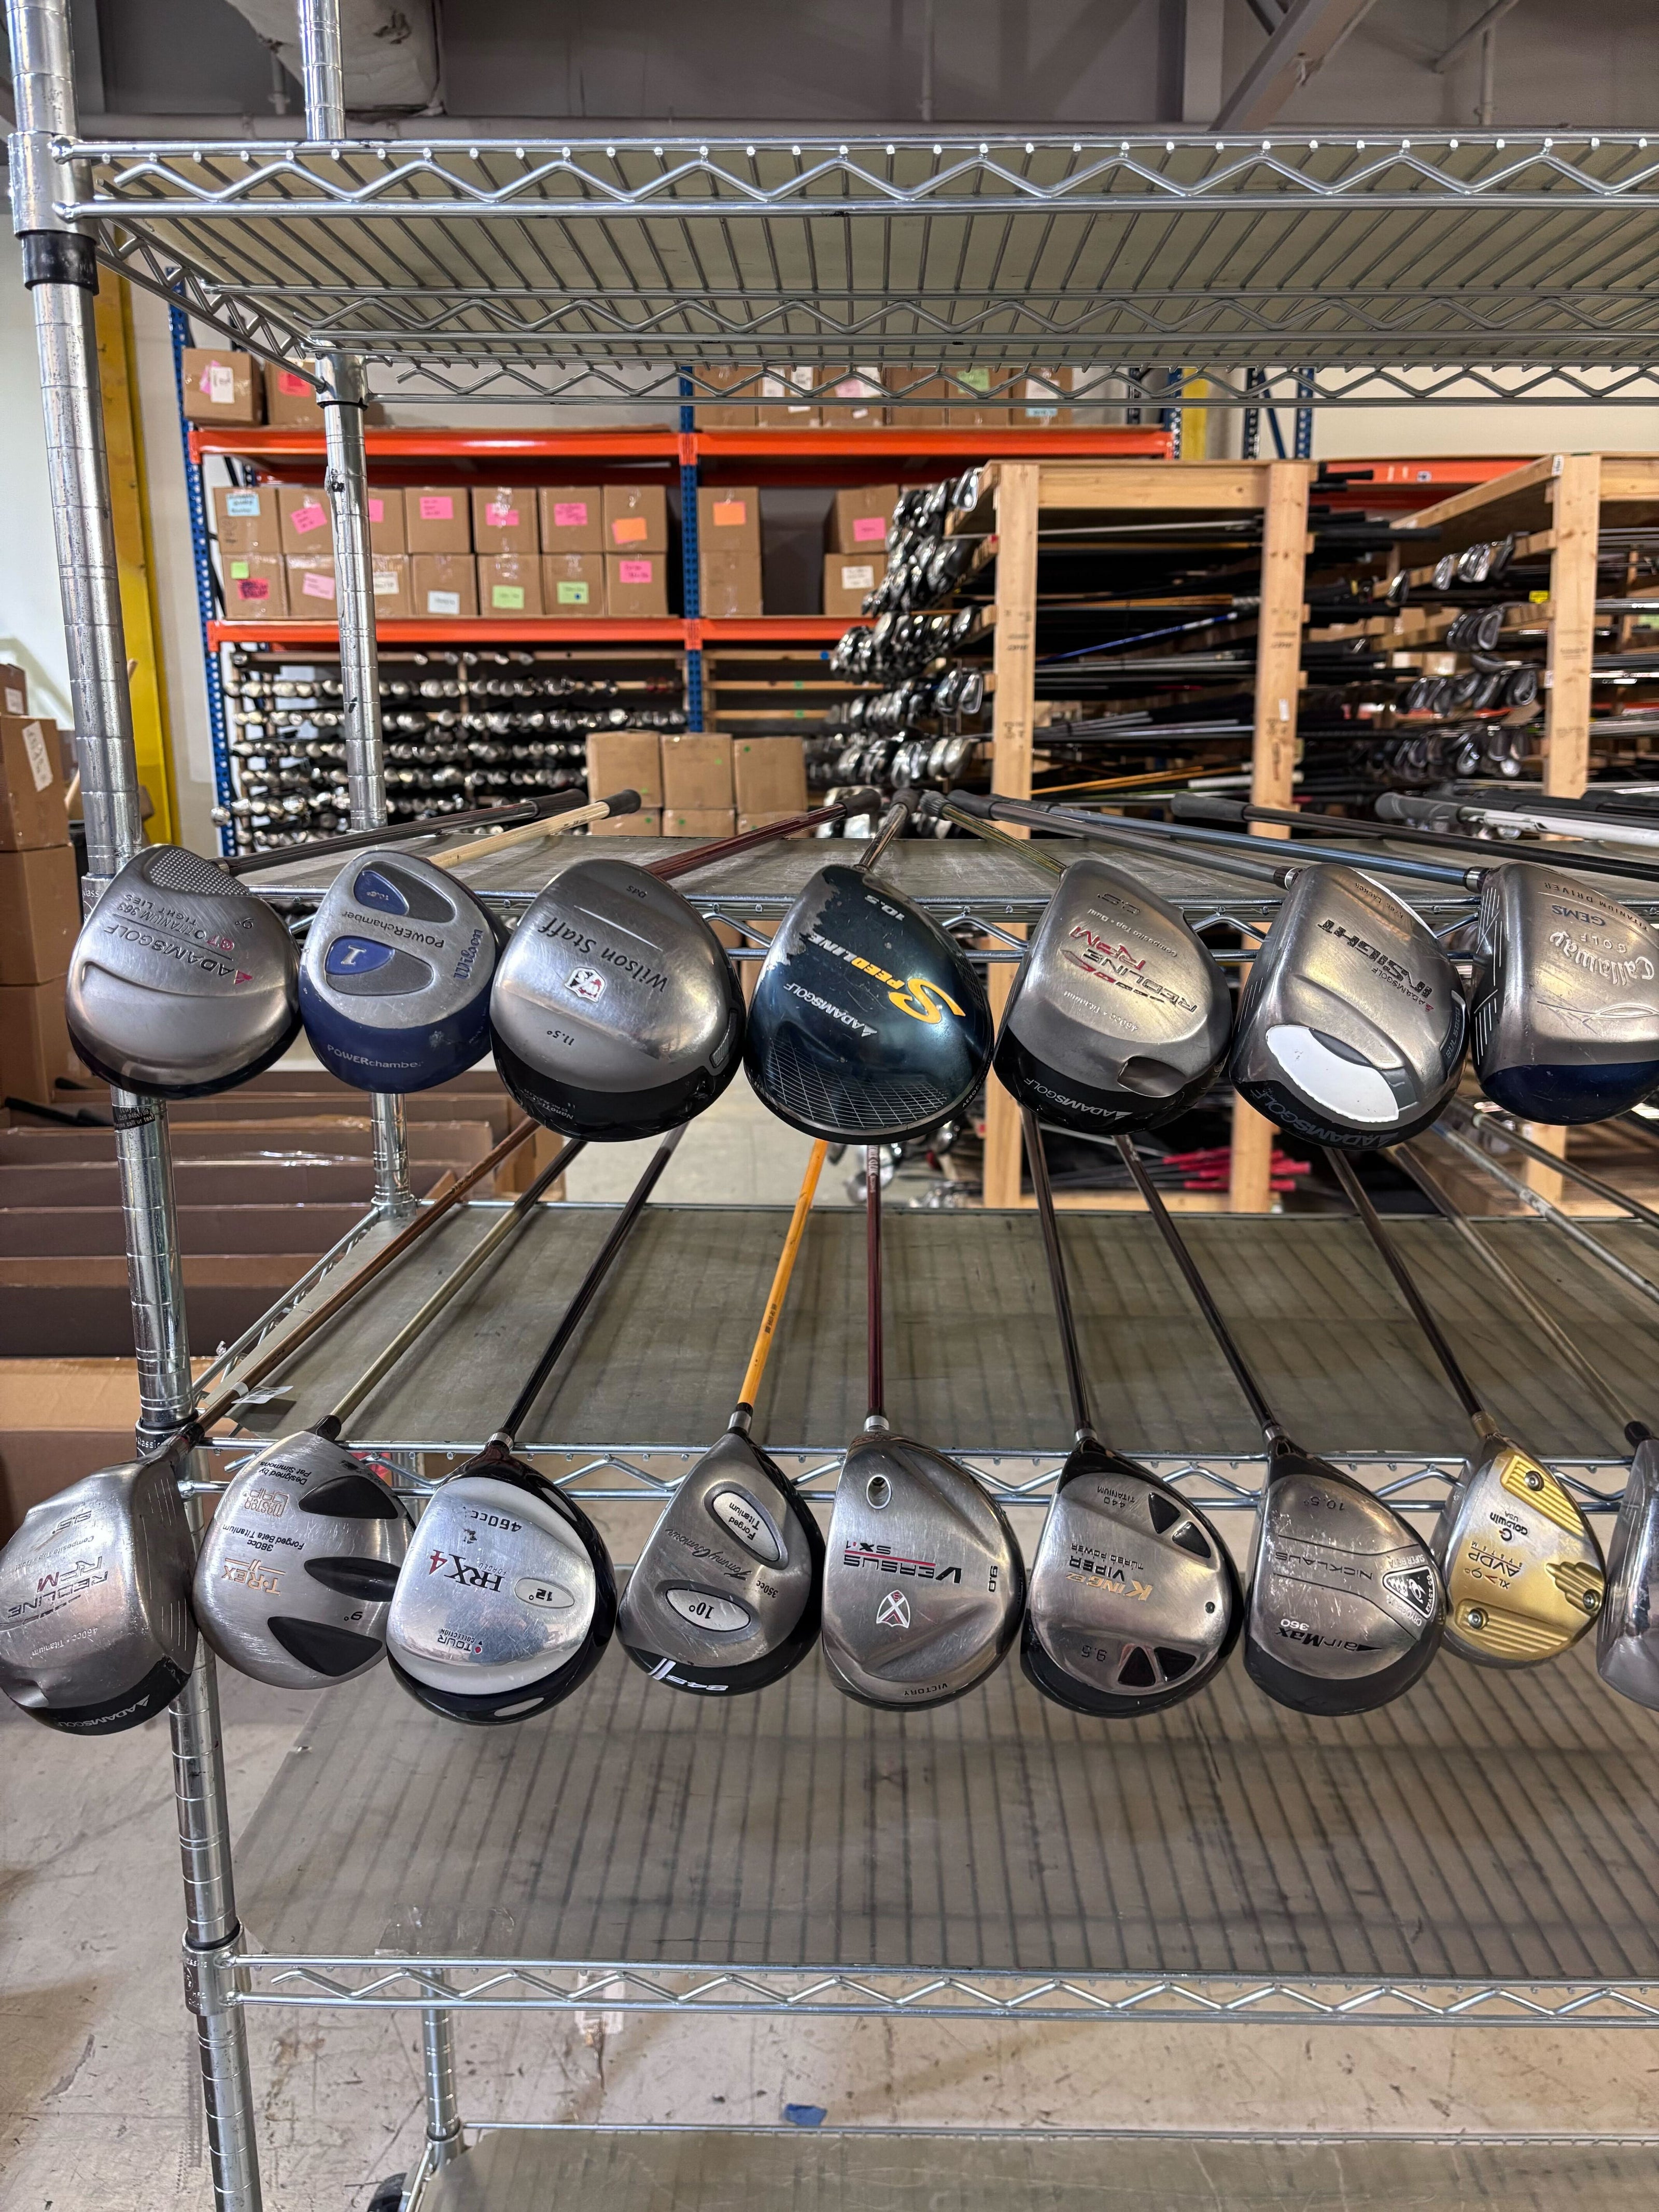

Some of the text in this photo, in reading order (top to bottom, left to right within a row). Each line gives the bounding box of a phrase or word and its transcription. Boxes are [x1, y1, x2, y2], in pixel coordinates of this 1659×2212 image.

[124, 893, 197, 926] TIGHT LIES
[863, 894, 905, 921] 10.5
[1544, 882, 1648, 932] TITANIUM DRIVER
[1552, 904, 1606, 926] GEMS
[117, 903, 195, 939] TITANIUM 363
[342, 910, 444, 948] POWERchamber
[1116, 920, 1131, 934] Top
[104, 924, 235, 977] ADAMSGOLF
[341, 945, 367, 965] 1
[454, 928, 482, 979] Wilson
[537, 917, 668, 993] Wilson Staff
[1069, 925, 1147, 970] RPM
[1133, 926, 1177, 958] Composite
[1580, 934, 1627, 953] GOLF
[1316, 918, 1432, 998] INSIGHT
[1549, 930, 1655, 986] Callaway
[809, 933, 966, 1024] SPEEDLINE
[1082, 947, 1197, 1013] REDLINE
[1371, 967, 1425, 1005] ADAMSGOLF
[783, 982, 861, 1030] ADAMSGOLF
[1063, 990, 1138, 1033] 460cc Titanium
[547, 1029, 575, 1046] 11.5°
[1023, 1076, 1115, 1117] ADAMSGOLF
[1250, 1088, 1376, 1147] ADAMSGOLF
[259, 1466, 307, 1485] Designed by
[296, 1467, 312, 1477] Pat
[1097, 1486, 1135, 1503] TITANIUM
[1104, 1496, 1126, 1509] 440
[1303, 1496, 1345, 1512] 10.5°
[244, 1498, 283, 1518] MASTER
[470, 1509, 522, 1533] 460cc
[728, 1502, 761, 1530] Titanium
[1504, 1511, 1519, 1522] USA
[222, 1524, 304, 1550] Forged Beta Titanium
[728, 1516, 756, 1541] Forged
[53, 1535, 94, 1555] Composite
[665, 1528, 752, 1581] Tommy Armour
[1071, 1543, 1144, 1570] TURBO POWER
[1471, 1541, 1523, 1569] SYSTEM
[429, 1549, 505, 1593] HRX 4
[843, 1554, 962, 1584] VERSUS
[1068, 1556, 1125, 1582] VIPER
[1274, 1552, 1372, 1581] NICKLAUS
[1468, 1552, 1521, 1577] AVDP
[756, 1579, 779, 1599] 350cc
[1086, 1575, 1153, 1601] KING
[1464, 1567, 1511, 1590] XL 9°
[7, 1571, 108, 1618] REDLINE
[528, 1587, 553, 1602] 12°
[344, 1611, 363, 1622] 9°
[688, 1601, 715, 1619] 10°
[440, 1628, 475, 1643] COLLECTION
[1281, 1618, 1310, 1630] 360
[32, 1626, 99, 1656] 460cc Titanium
[437, 1635, 472, 1652] TOUR
[1274, 1626, 1358, 1651] airMax
[903, 1682, 948, 1696] VICTORY
[55, 1702, 137, 1727] ADAMSGOLF
